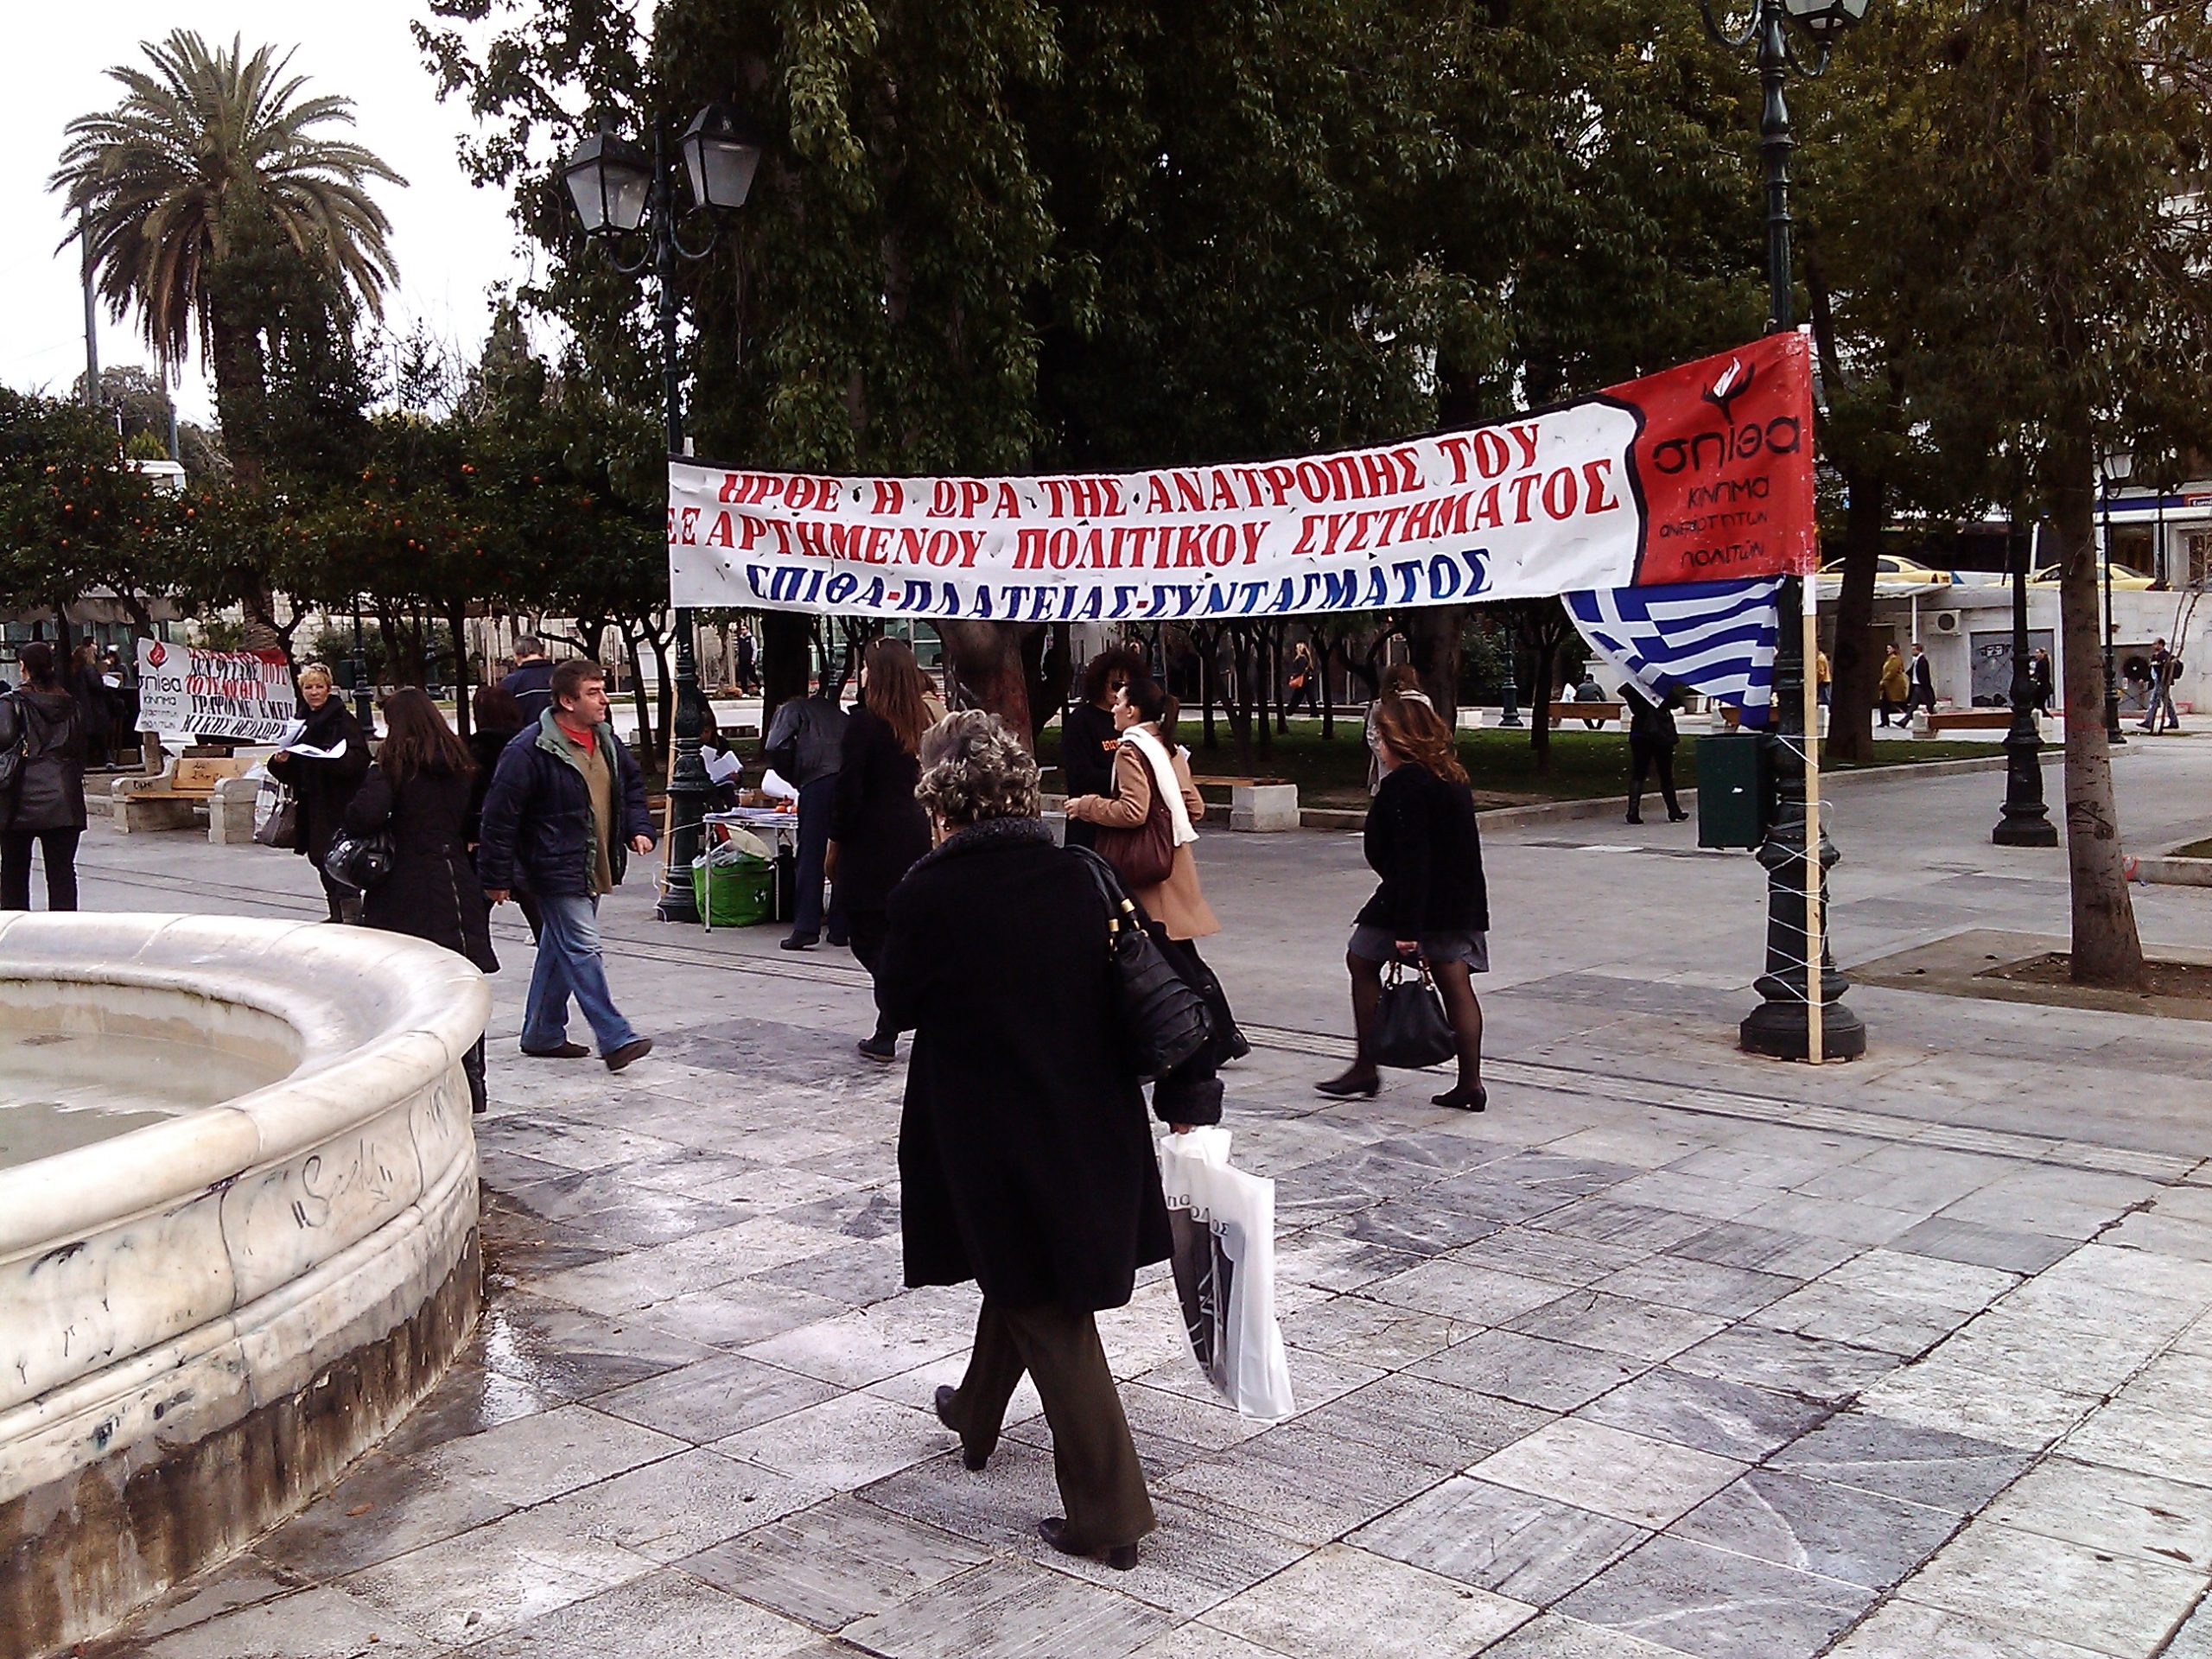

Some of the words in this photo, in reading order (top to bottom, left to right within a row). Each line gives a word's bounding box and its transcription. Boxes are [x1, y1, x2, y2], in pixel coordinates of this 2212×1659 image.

[718, 474, 843, 512] ΗΡΘΕ
[871, 480, 903, 514] Η
[926, 480, 1021, 518] ΩΡΑ
[1038, 479, 1127, 518] ΤΗΣ
[1146, 447, 1425, 513] ΑΝΑΤΡΟΠΗΣ
[1434, 423, 1541, 486] ΤΟΥ
[1012, 521, 1271, 569] ΠΟΛΙΤΙΚΟΥ
[1292, 459, 1620, 556] ΣΥΣΤΗΜΑΤΟΣ
